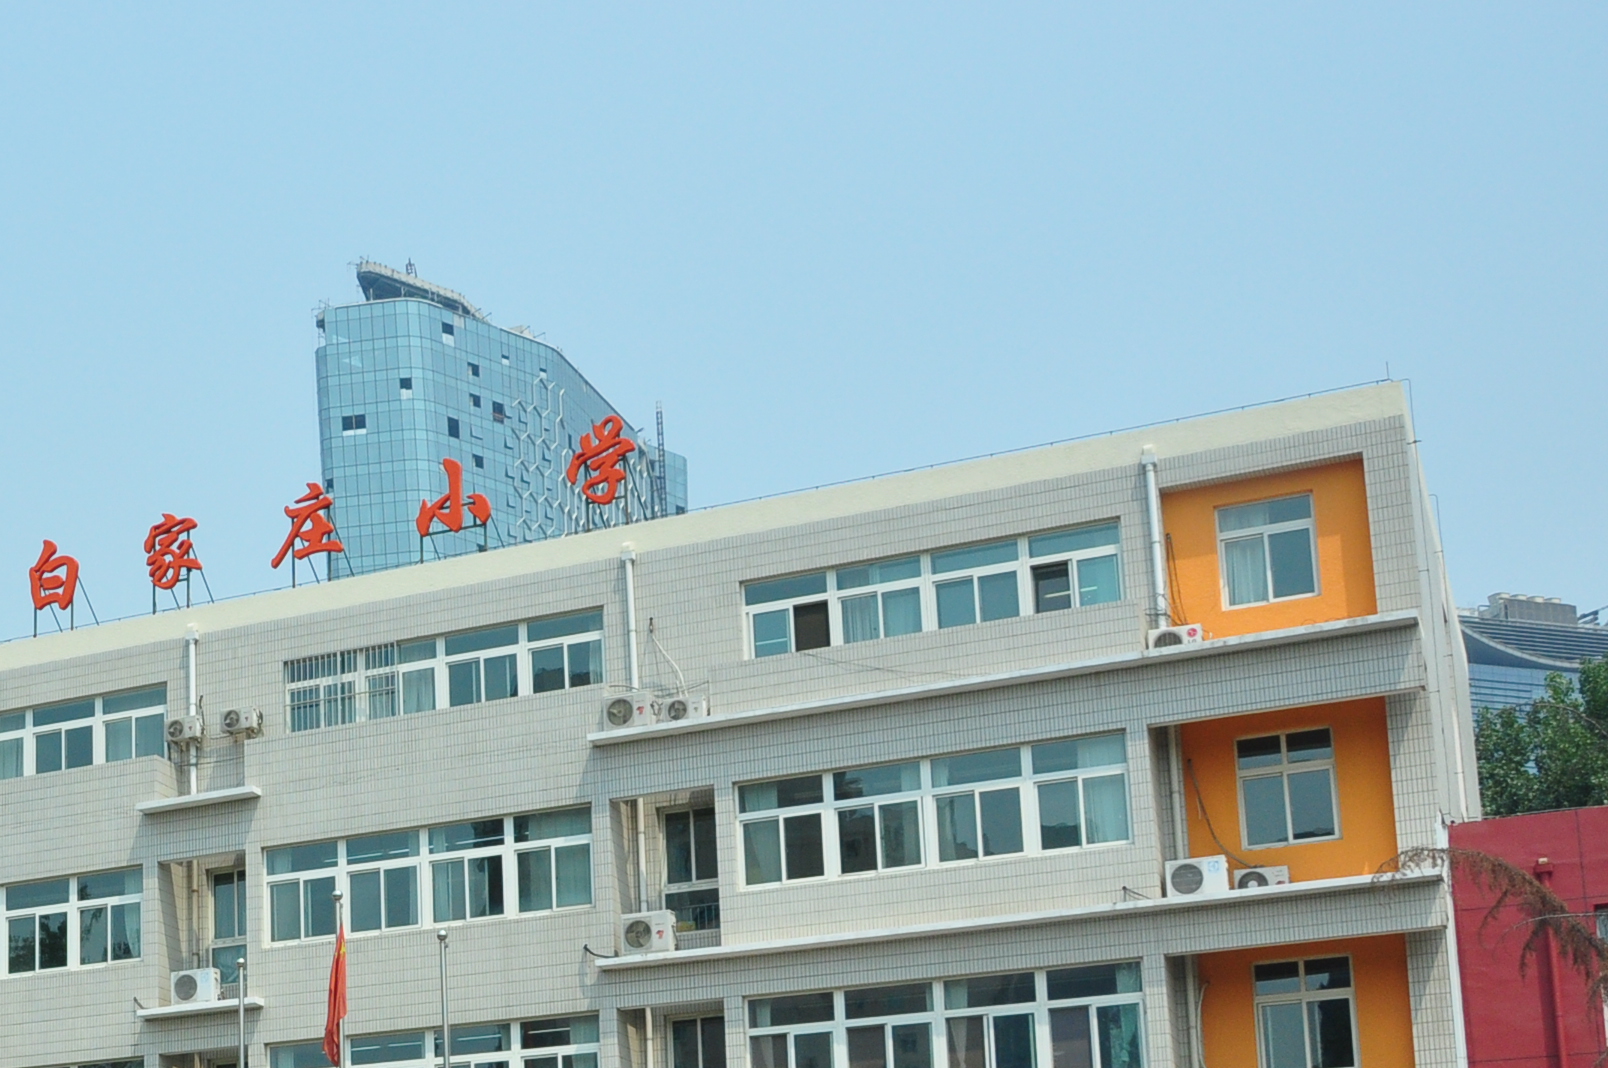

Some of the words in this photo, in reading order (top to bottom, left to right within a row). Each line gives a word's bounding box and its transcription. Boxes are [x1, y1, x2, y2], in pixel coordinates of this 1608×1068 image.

[28, 414, 638, 611] 白家庄小学
